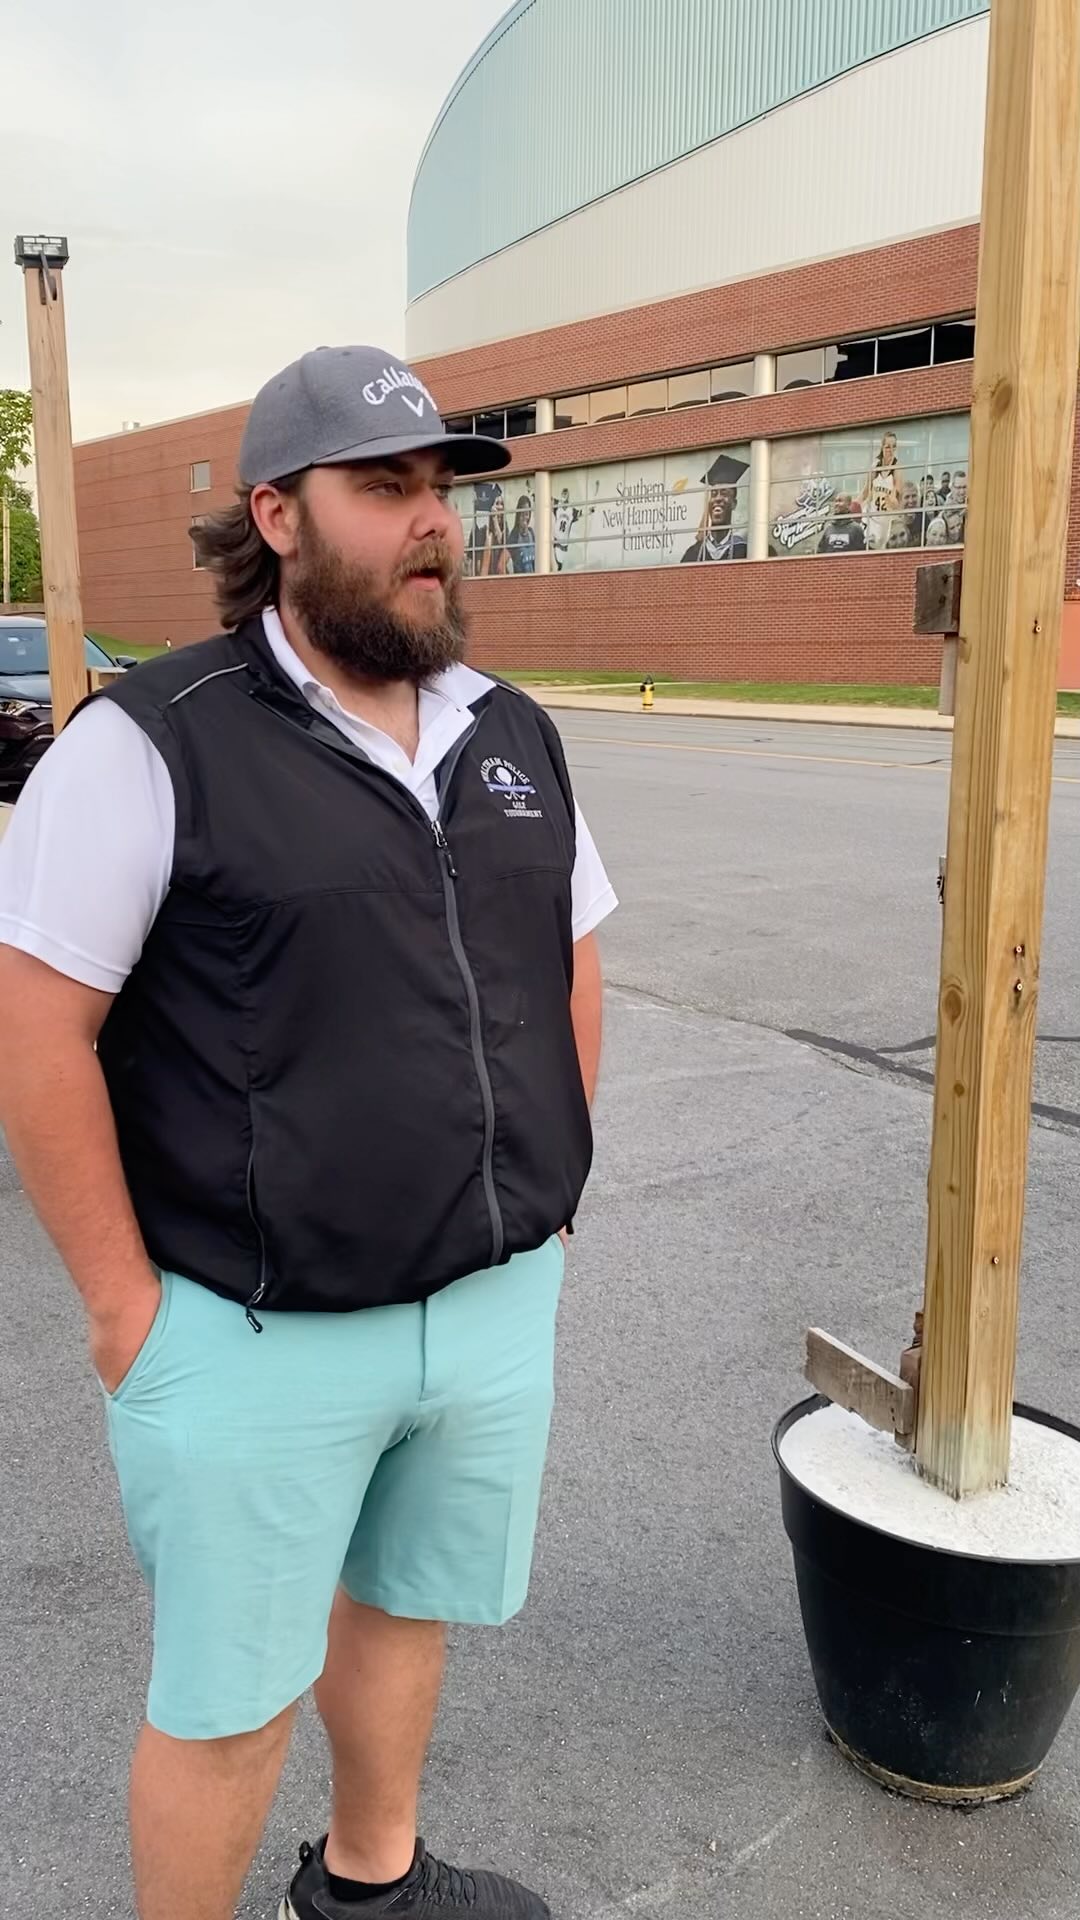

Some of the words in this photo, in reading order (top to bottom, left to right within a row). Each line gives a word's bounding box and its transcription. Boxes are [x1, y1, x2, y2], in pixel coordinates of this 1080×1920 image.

[362, 366, 438, 411] Calla
[615, 477, 665, 506] Southern
[602, 509, 623, 529] New
[627, 494, 687, 531] Hampshire
[623, 525, 674, 554] University
